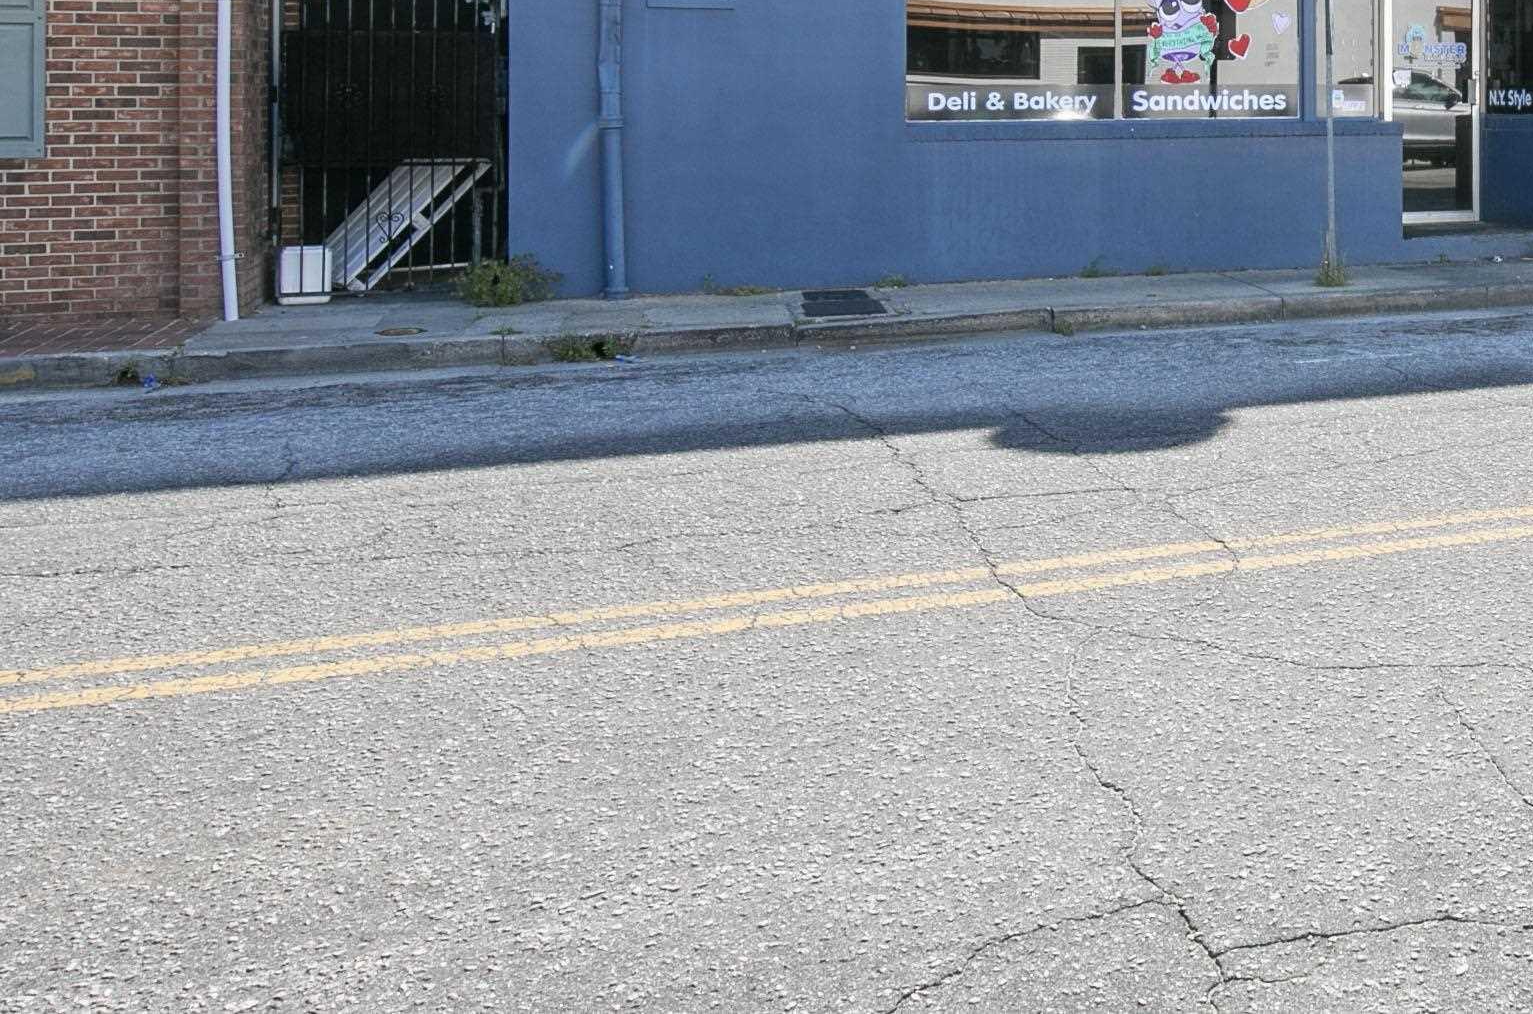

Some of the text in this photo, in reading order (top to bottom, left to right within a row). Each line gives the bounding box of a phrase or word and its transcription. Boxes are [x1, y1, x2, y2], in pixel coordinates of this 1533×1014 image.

[928, 92, 1097, 113] Deli & Bakery
[1132, 90, 1288, 113] Sandwiches
[1507, 88, 1532, 110] Style
